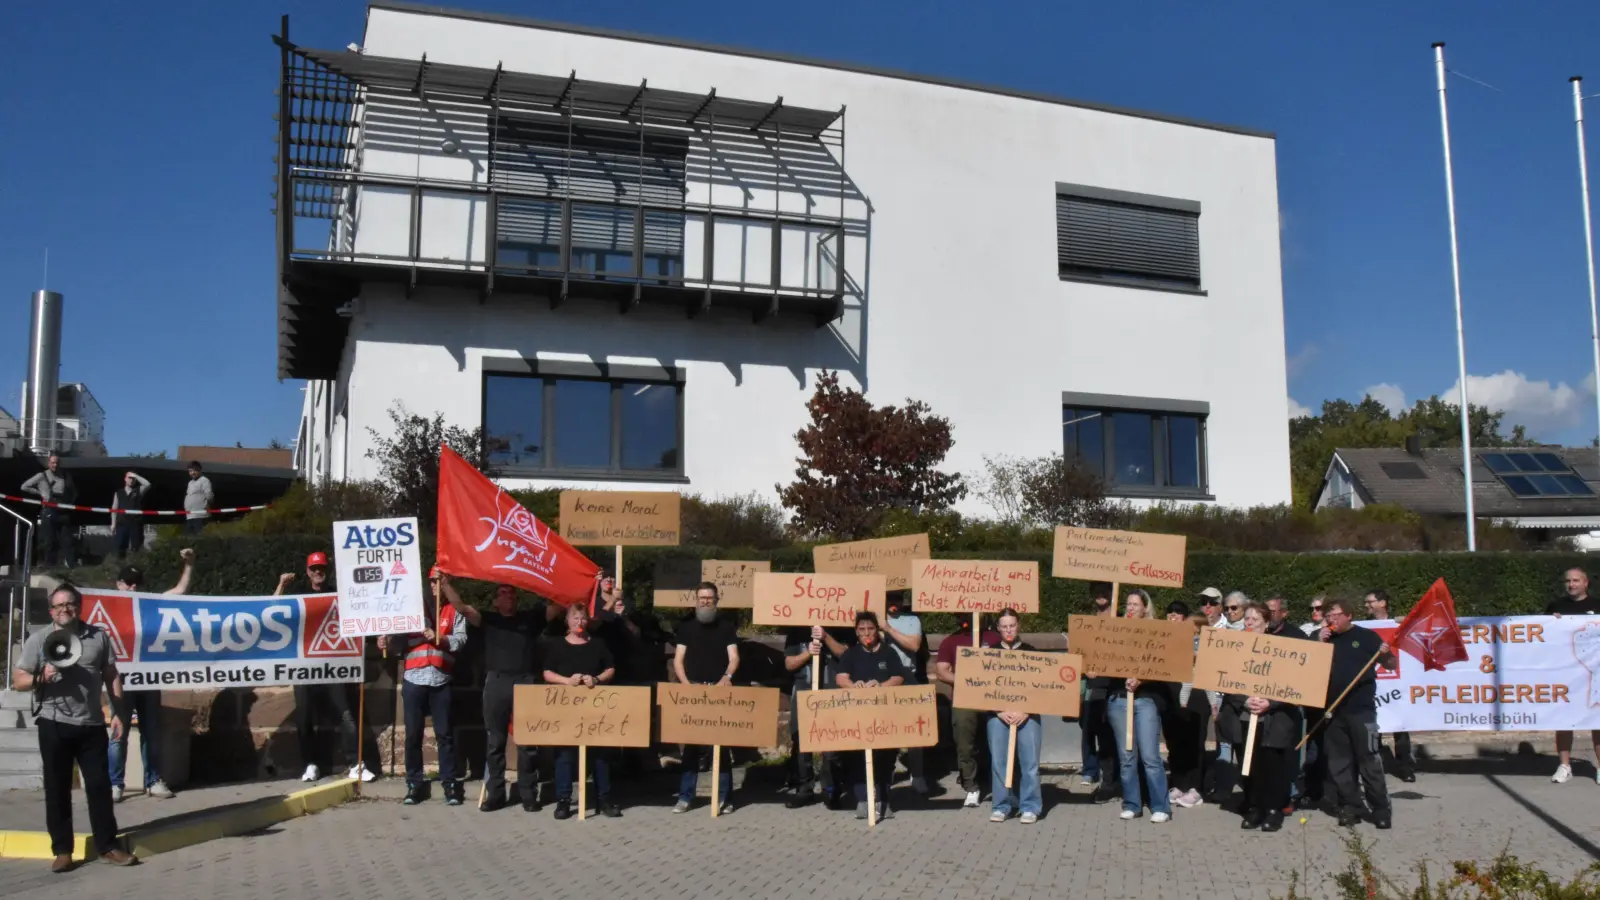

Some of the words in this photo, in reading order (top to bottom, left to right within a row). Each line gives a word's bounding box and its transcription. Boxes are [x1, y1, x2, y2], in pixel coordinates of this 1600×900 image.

[575, 497, 613, 513] Keine
[622, 500, 660, 515] Moral
[343, 522, 414, 549] Atos
[921, 563, 999, 582] Mehrarbeit
[1008, 568, 1032, 582] und
[1129, 561, 1182, 582] Entlassen
[384, 578, 403, 595] IT
[793, 575, 847, 602] Stopp
[940, 581, 1012, 596] Hochleistung
[917, 592, 949, 610] folgt
[772, 604, 792, 619] so
[148, 606, 292, 653] Atos
[343, 615, 421, 634] EVIDEN
[1460, 623, 1546, 644] ERNER
[1251, 637, 1307, 666] Lösung
[121, 665, 265, 686] rauensleute
[274, 662, 361, 681] Franken
[1479, 655, 1496, 674] &
[1253, 682, 1303, 701] schließen
[1410, 684, 1570, 704] PFLEIDERER
[668, 690, 756, 713] Verantwortung
[526, 719, 560, 733] was
[1444, 712, 1537, 725] Dinkelsbühl
